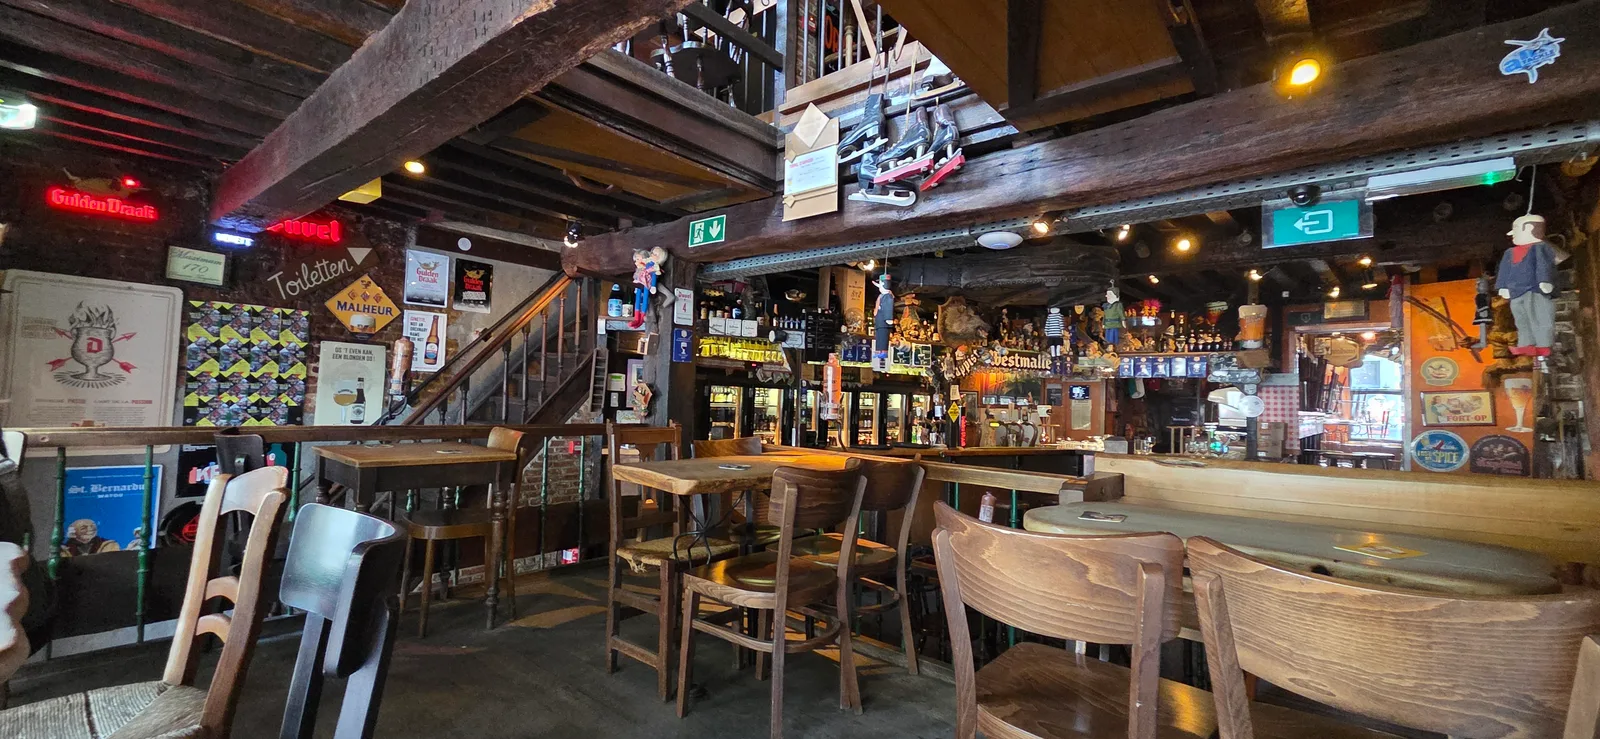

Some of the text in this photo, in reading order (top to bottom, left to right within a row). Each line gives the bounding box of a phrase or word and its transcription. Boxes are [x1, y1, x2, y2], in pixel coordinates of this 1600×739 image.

[51, 189, 155, 219] Gulden Draak
[267, 220, 340, 242] uvel
[183, 263, 209, 273] 170
[416, 267, 439, 278] Gulden
[268, 258, 353, 300] Toiletten
[418, 276, 438, 284] Draak
[463, 276, 484, 286] Gulden
[336, 300, 393, 316] MALHEUR
[682, 302, 687, 312] 4
[90, 482, 145, 493] Bernardu
